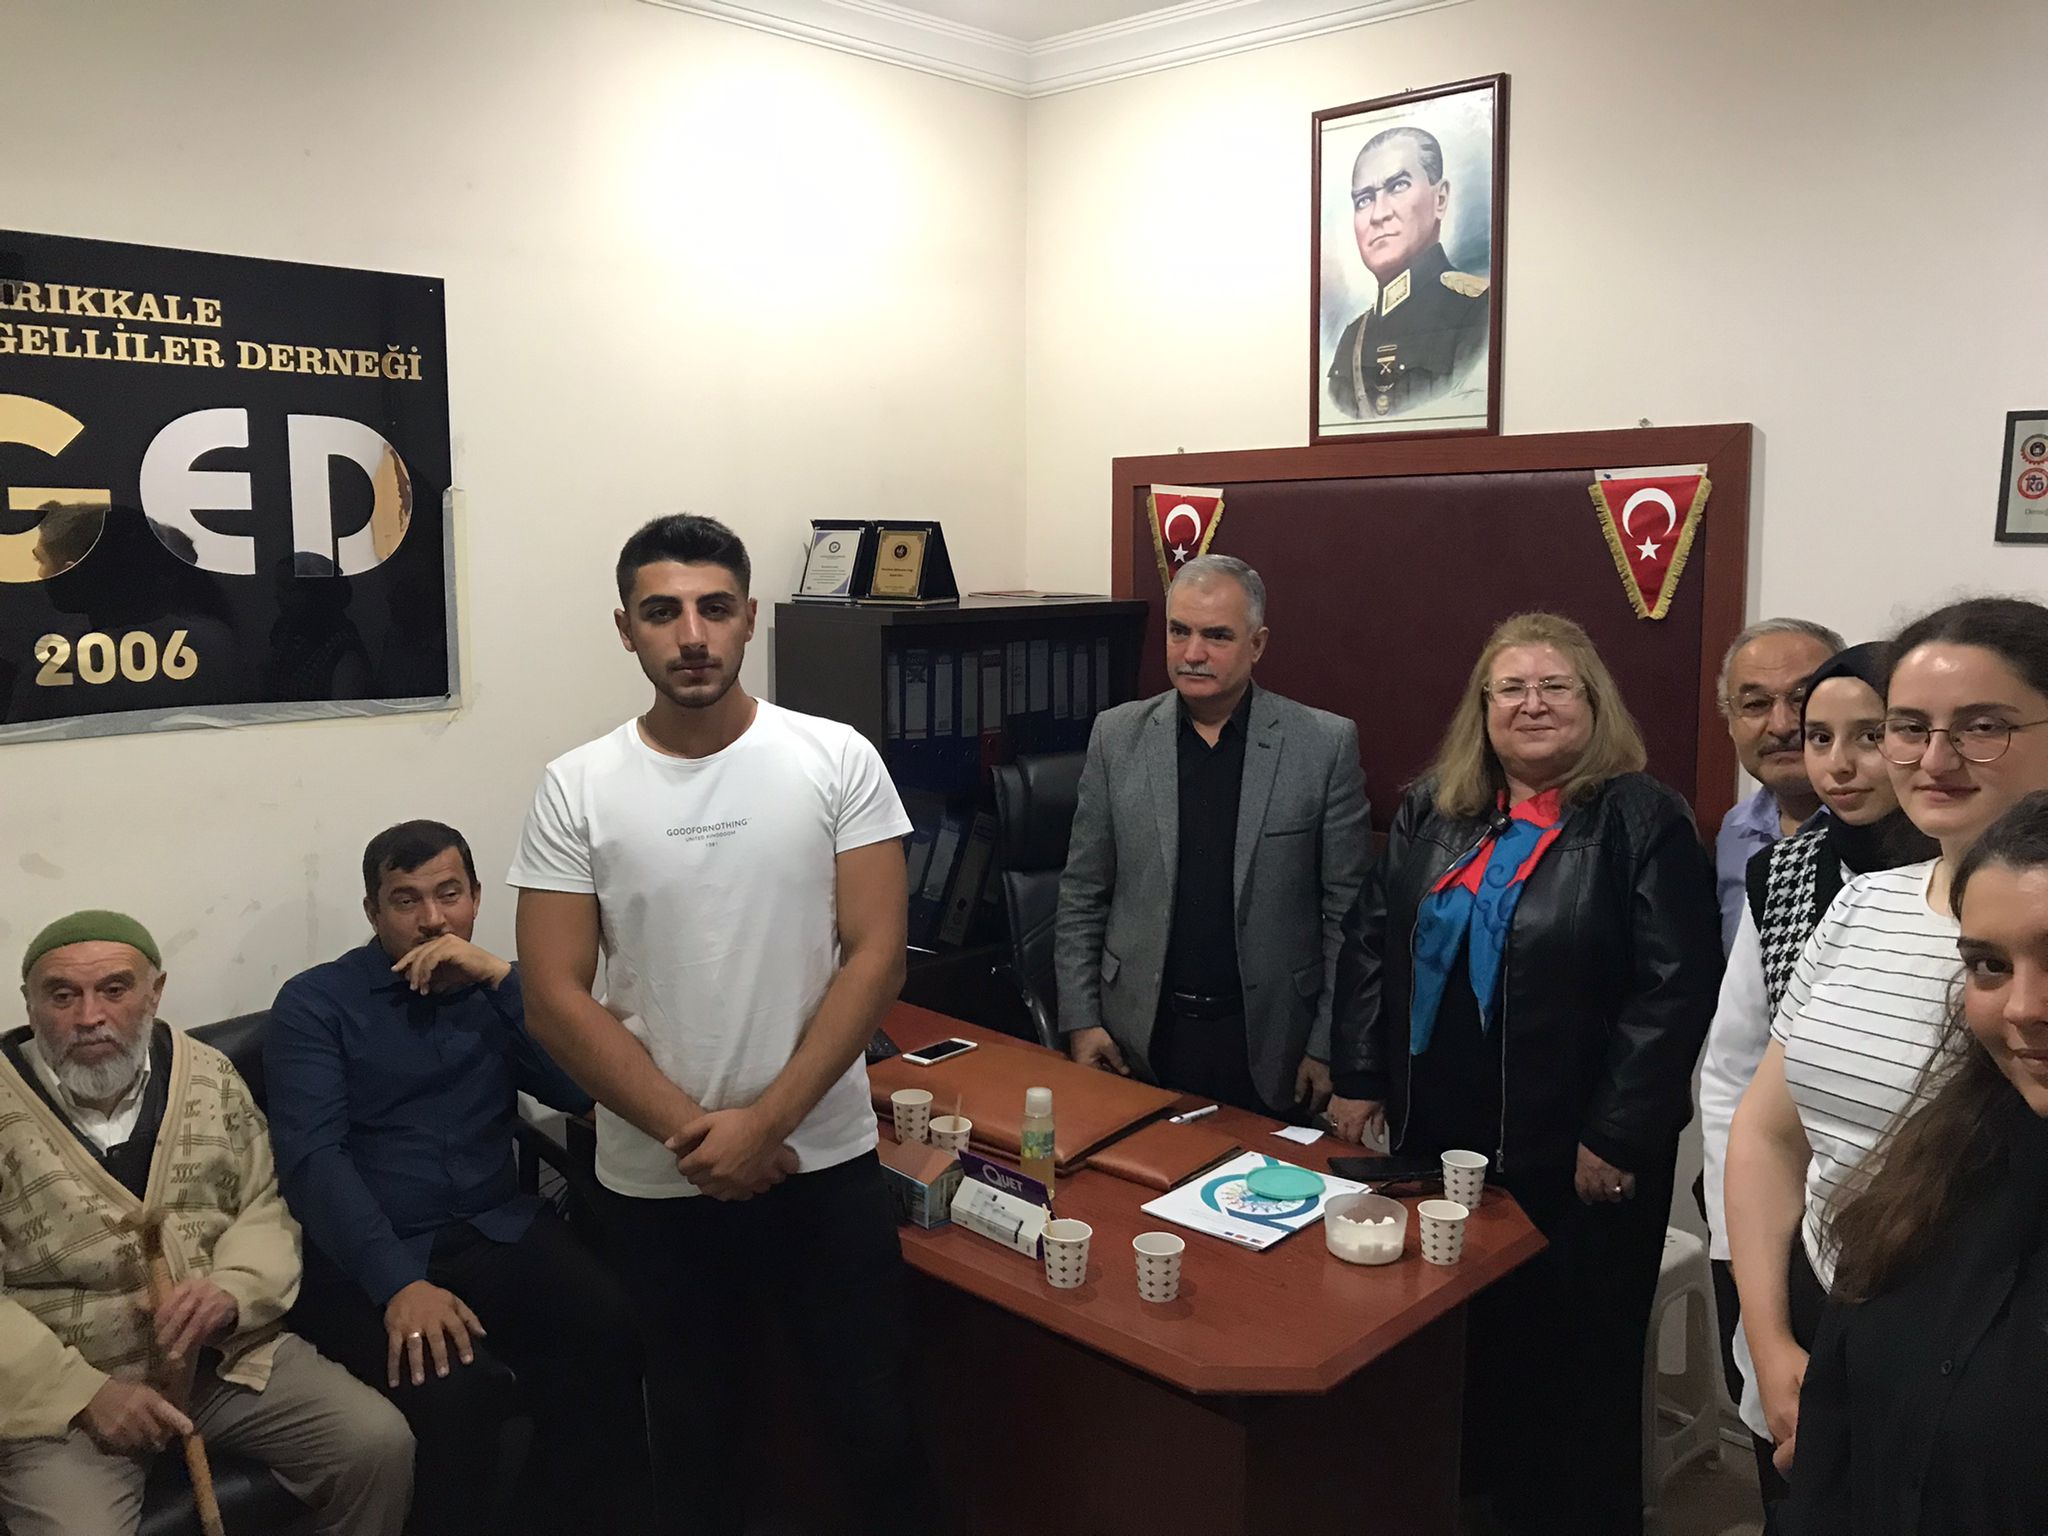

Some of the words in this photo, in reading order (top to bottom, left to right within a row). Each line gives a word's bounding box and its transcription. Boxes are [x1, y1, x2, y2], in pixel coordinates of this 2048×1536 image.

[236, 341, 423, 381] DERNEĞİ
[34, 629, 199, 686] 2006
[982, 1164, 1023, 1192] QUET
